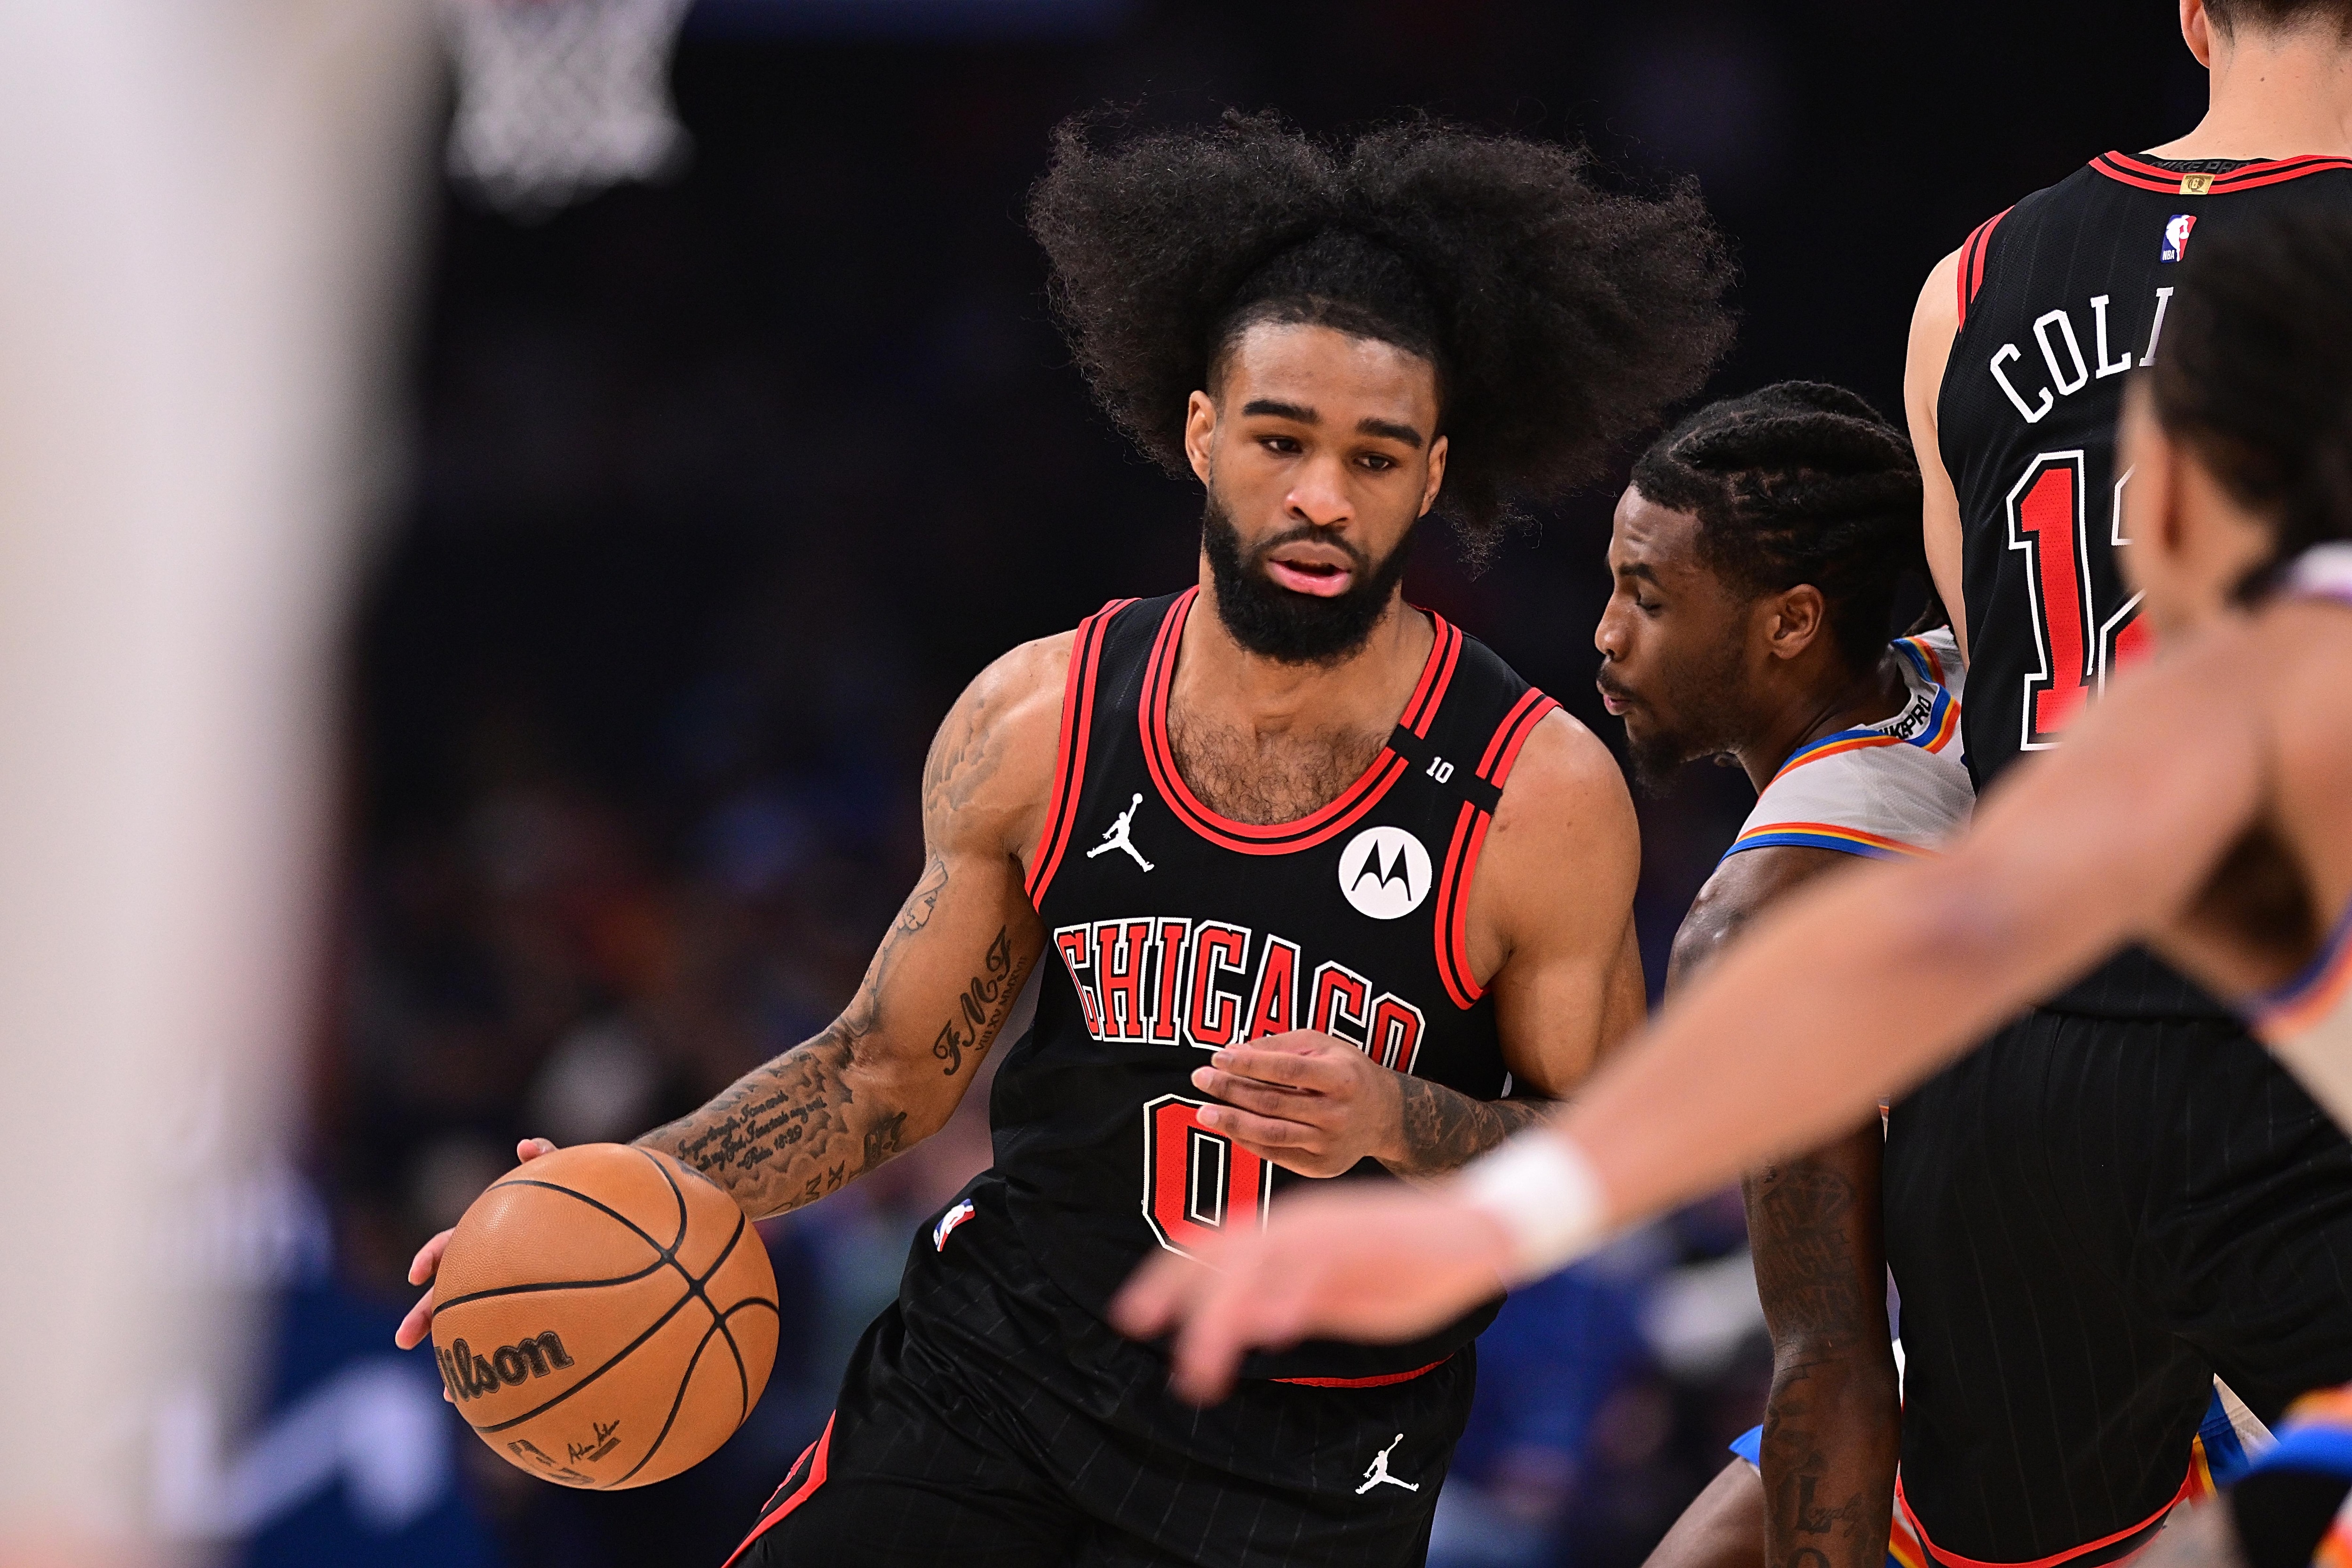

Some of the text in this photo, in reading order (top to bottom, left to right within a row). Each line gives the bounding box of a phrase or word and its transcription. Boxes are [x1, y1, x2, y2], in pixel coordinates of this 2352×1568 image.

[2162, 250, 2175, 261] NBA
[1426, 756, 1454, 784] 10
[1053, 917, 1426, 1075] CHICAGO
[1142, 1093, 1272, 1268] 0
